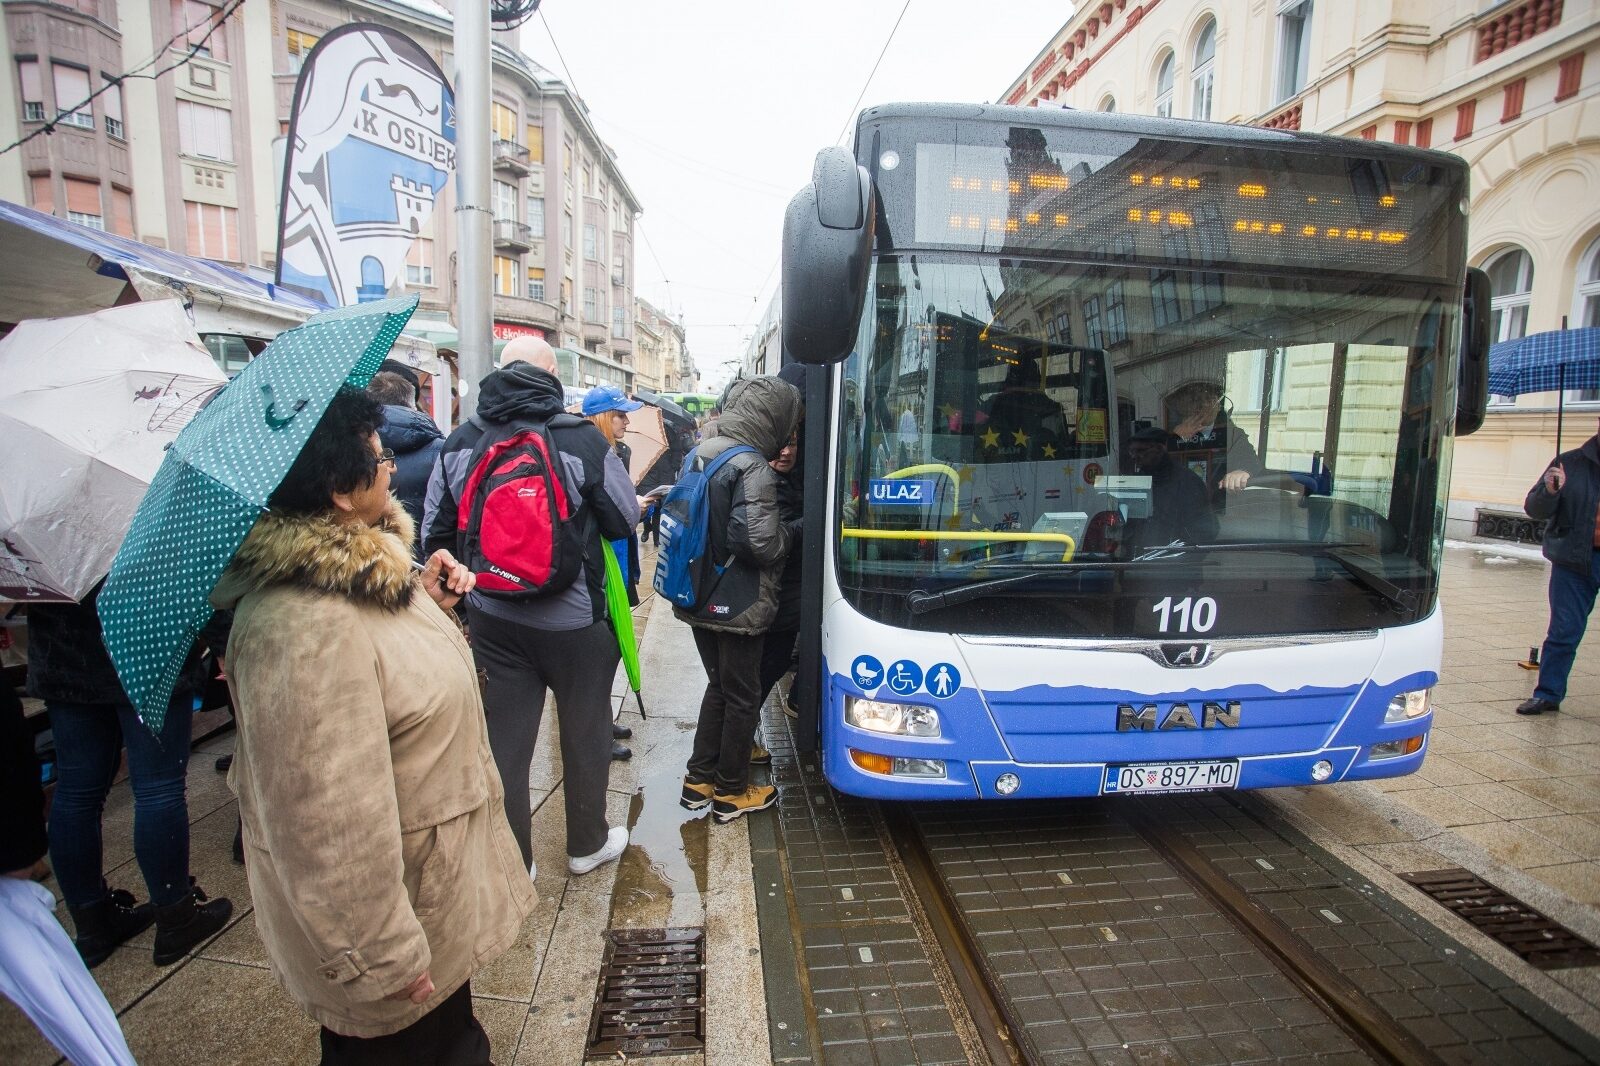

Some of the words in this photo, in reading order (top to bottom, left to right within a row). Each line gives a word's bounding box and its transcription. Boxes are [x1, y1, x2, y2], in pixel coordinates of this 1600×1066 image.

[873, 484, 921, 500] ULAZ
[489, 565, 521, 583] LI-NING
[1152, 596, 1217, 633] 110
[1116, 701, 1241, 732] MAN
[1120, 768, 1146, 788] OS
[1160, 764, 1233, 787] 897-MO
